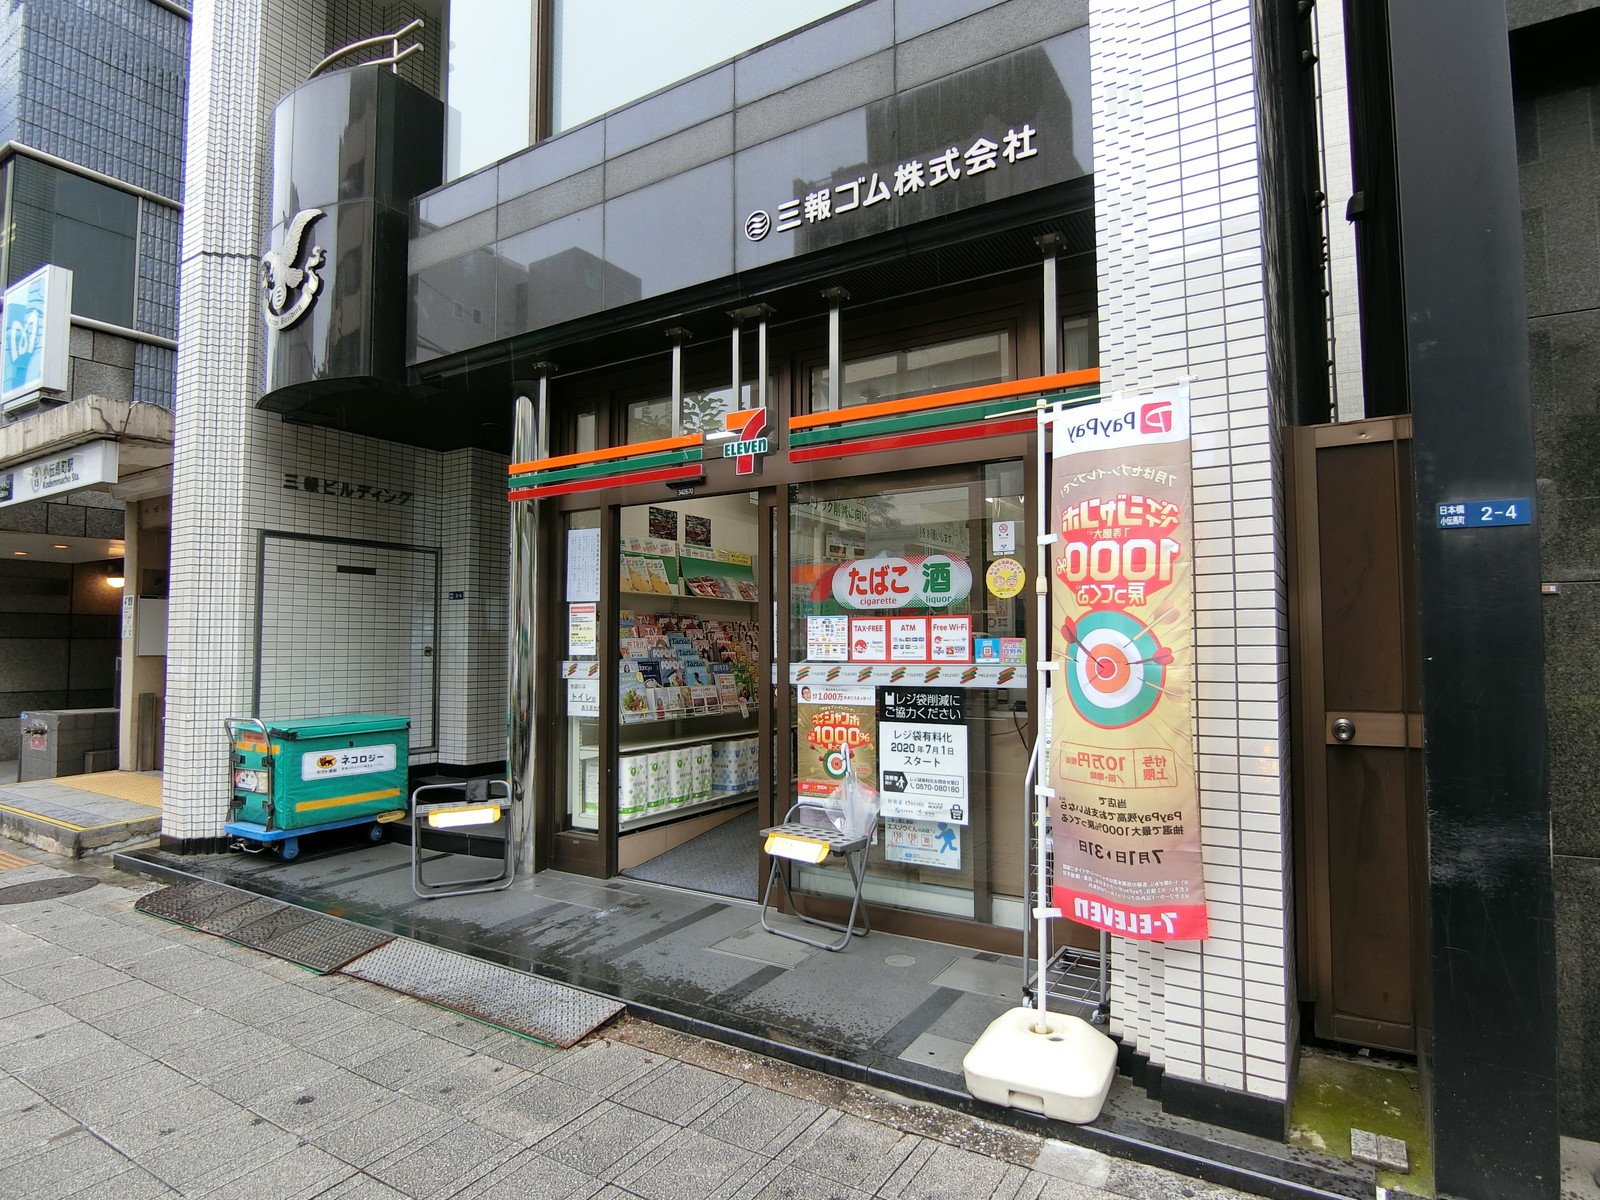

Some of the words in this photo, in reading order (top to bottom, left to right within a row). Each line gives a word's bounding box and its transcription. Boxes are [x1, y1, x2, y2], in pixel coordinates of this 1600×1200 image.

[776, 123, 1038, 233] 三報ゴム株式会社
[1439, 505, 1465, 515] 日本橋
[1480, 504, 1518, 521] 2-4
[1439, 516, 1465, 526] 小伝馬町
[848, 564, 910, 596] たばこ
[922, 562, 951, 593] 酒
[859, 596, 897, 606] cigarette
[925, 595, 952, 604] liquor
[900, 624, 917, 632] ATM
[932, 623, 948, 631] Free
[948, 623, 968, 631] Wi-Fi
[896, 693, 960, 707] レジ袋削減に
[885, 706, 961, 720] ご協力ください
[813, 725, 870, 746] 1000%
[894, 729, 953, 743] レジ袋有料化
[341, 753, 385, 765] ネコロジー
[904, 755, 940, 767] スタート
